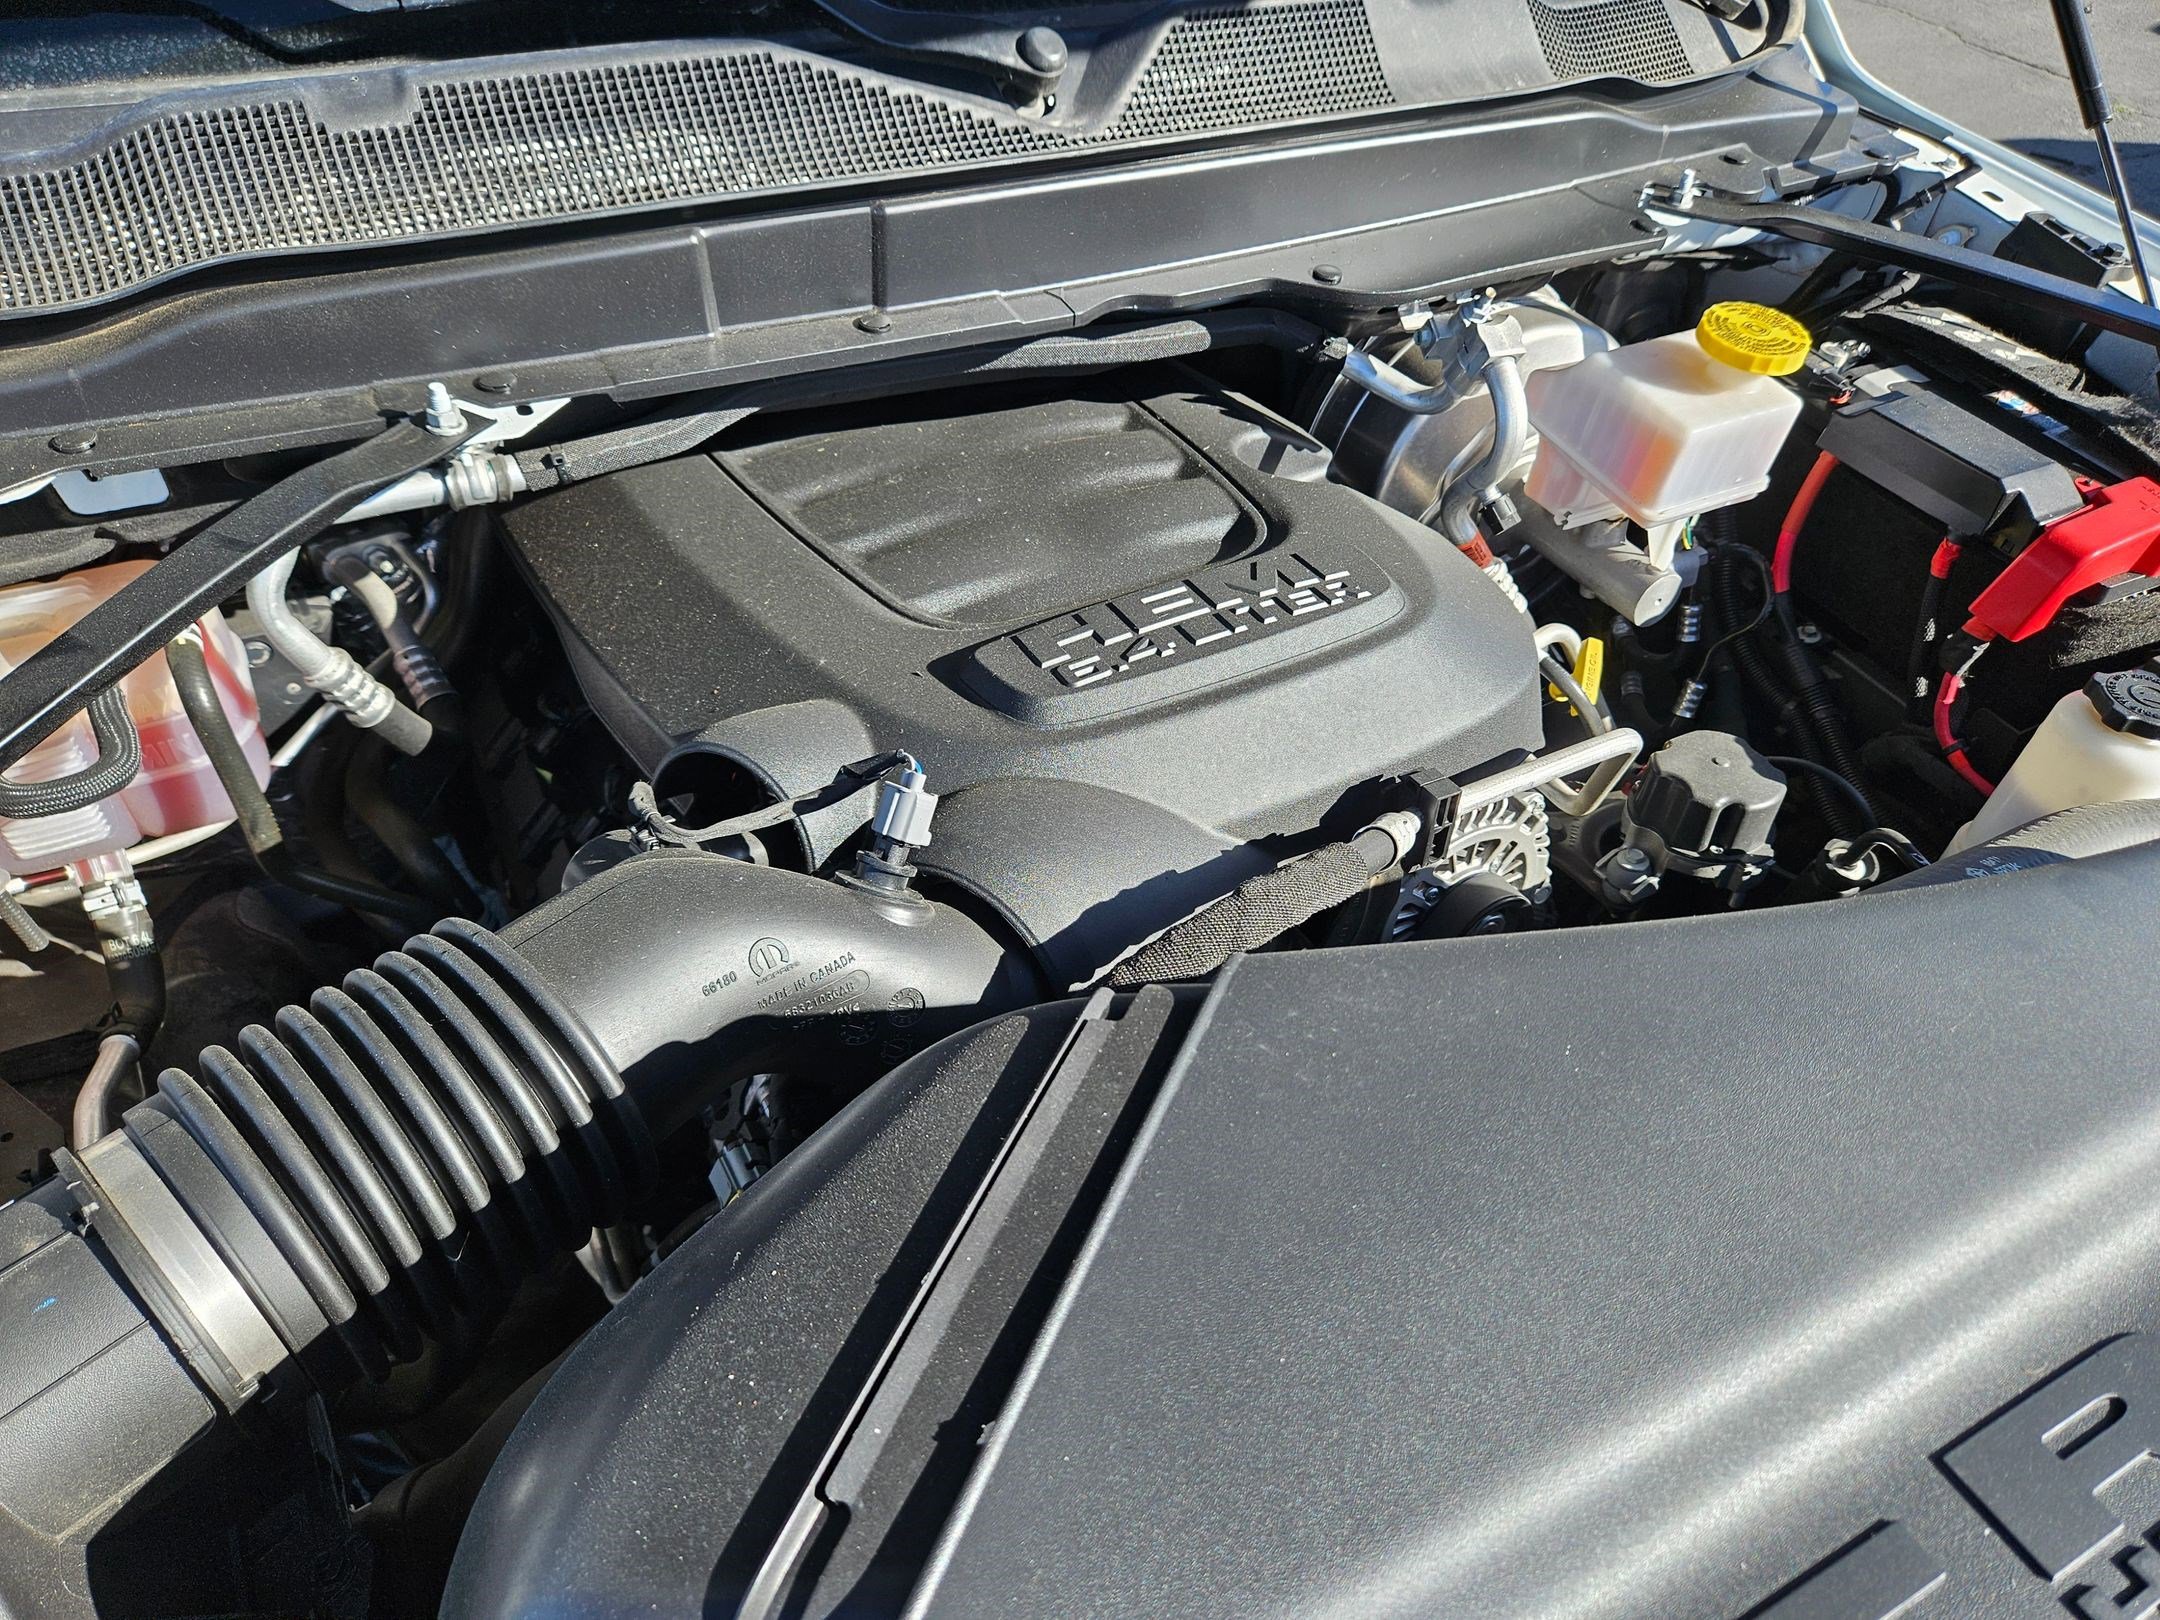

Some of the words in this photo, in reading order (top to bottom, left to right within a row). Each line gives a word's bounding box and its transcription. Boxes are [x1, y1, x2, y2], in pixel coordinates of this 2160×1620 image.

[1008, 554, 1351, 668] HEMI
[1175, 581, 1372, 647] LITER
[108, 936, 130, 952] BOT
[701, 970, 738, 997] 66180
[757, 985, 792, 1010] MADE
[795, 977, 807, 992] IN
[809, 951, 857, 984] CANADA
